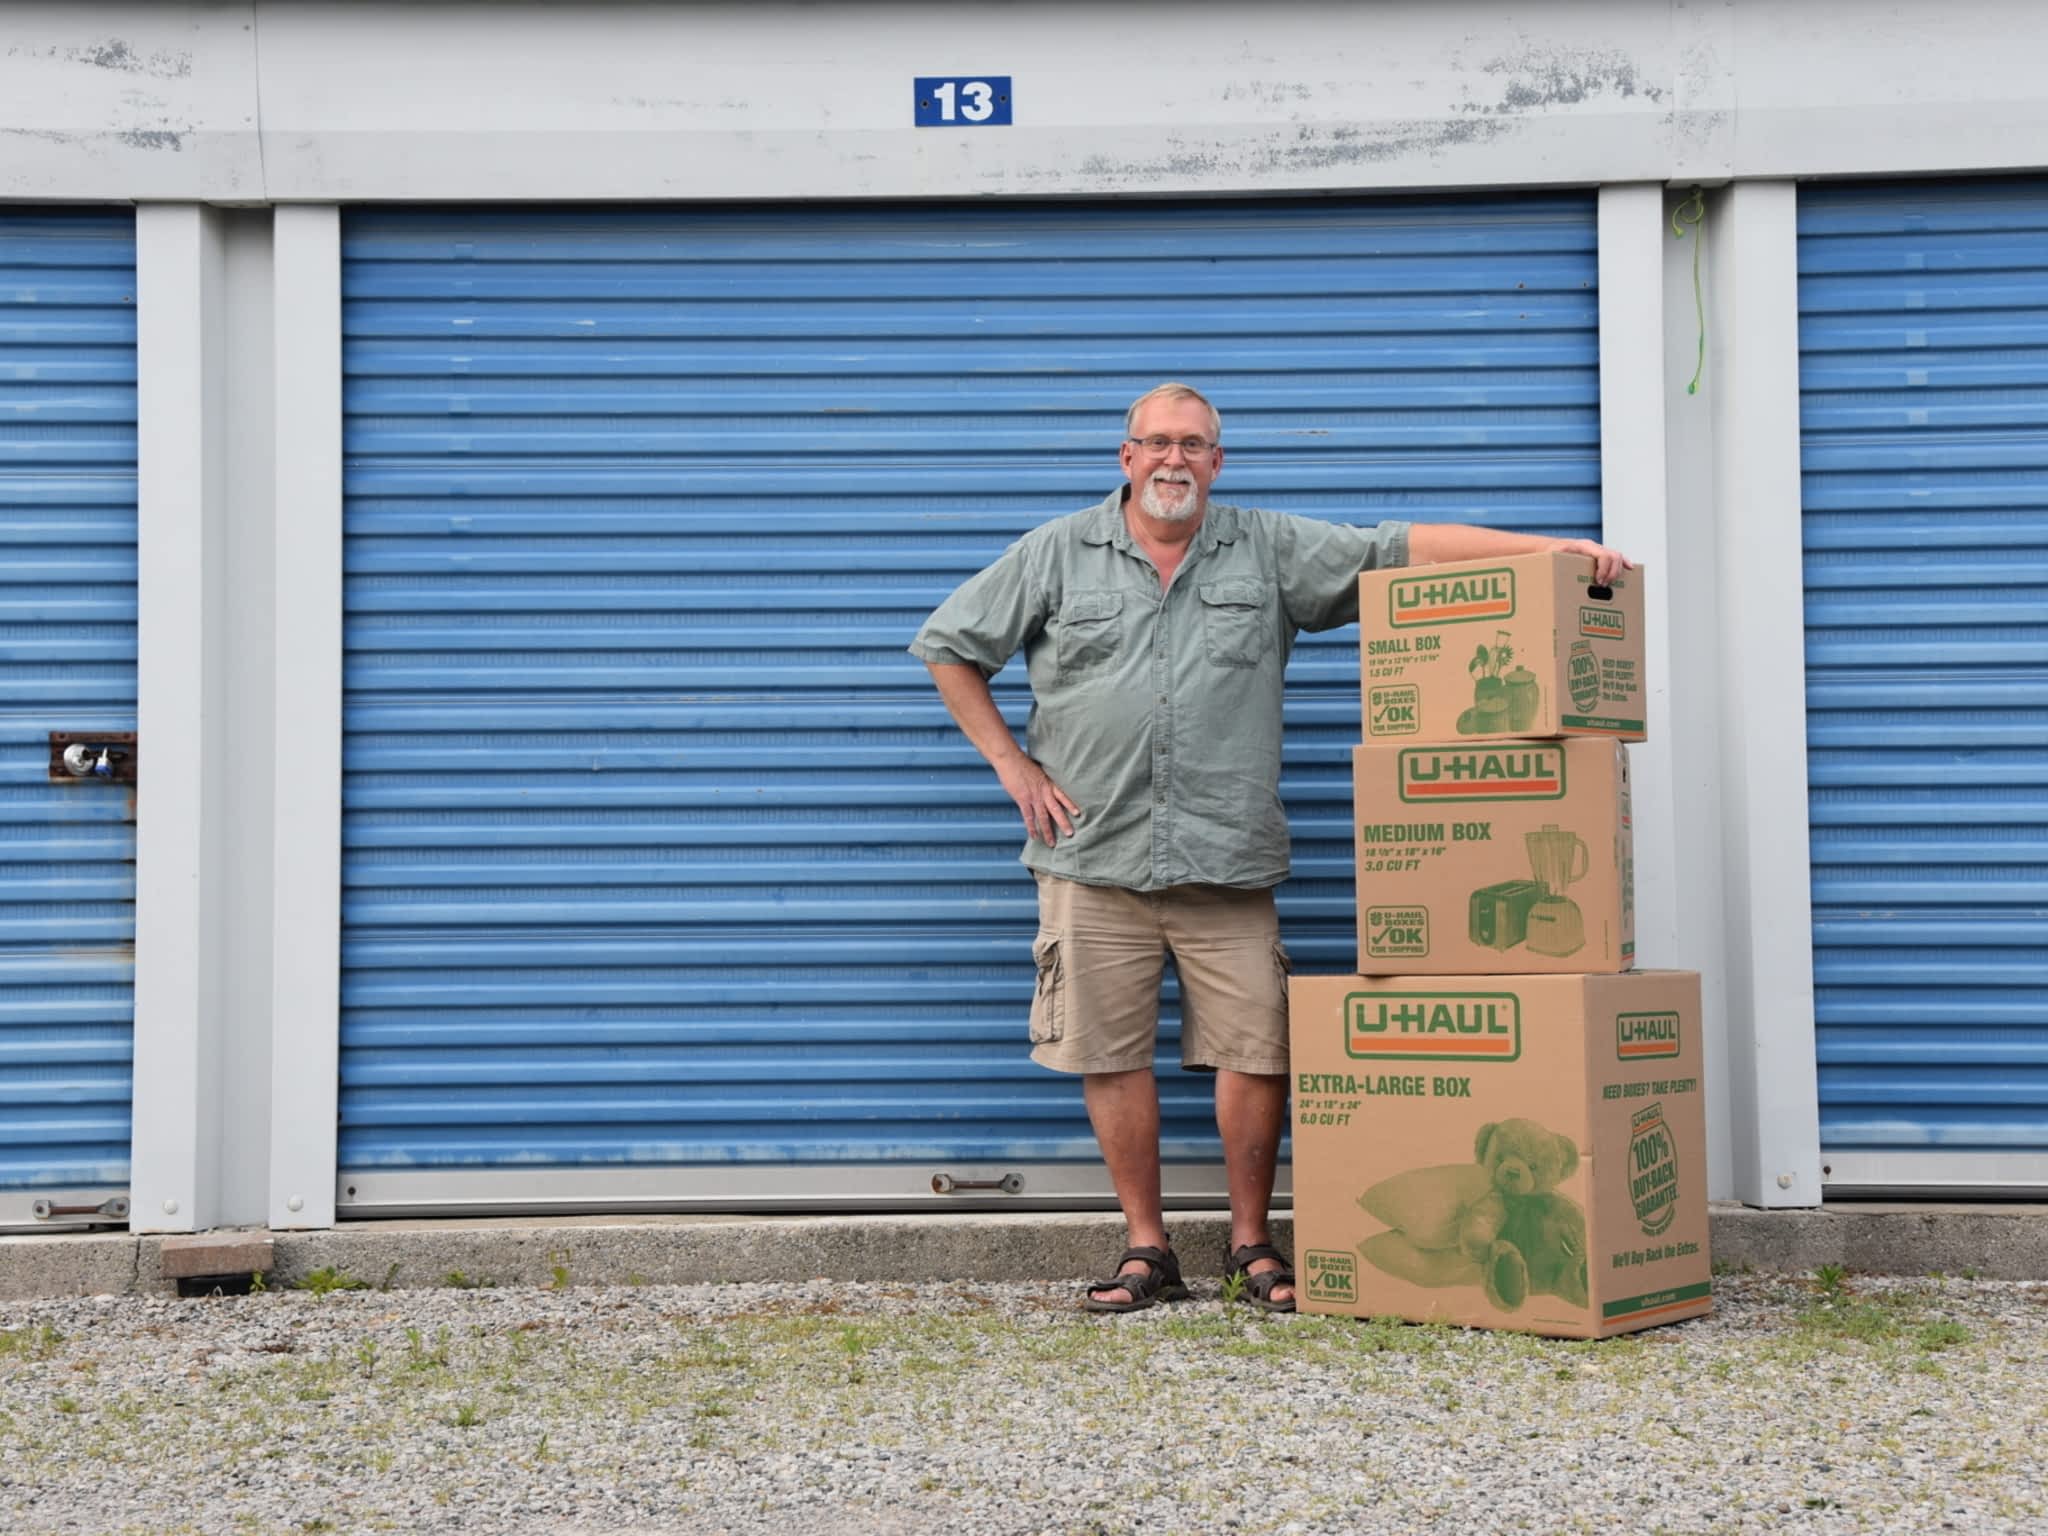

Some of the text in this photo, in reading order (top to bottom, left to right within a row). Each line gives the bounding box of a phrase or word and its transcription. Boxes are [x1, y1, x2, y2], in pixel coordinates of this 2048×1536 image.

[934, 82, 993, 121] 13
[1397, 577, 1507, 608] U-HAUL
[1583, 611, 1621, 628] U-HAUL
[1368, 634, 1441, 655] SMALL BOX
[1370, 666, 1404, 677] 1.5 CU FT
[1388, 706, 1415, 721] OK
[1410, 753, 1554, 781] U-HAUL
[1364, 822, 1492, 842] MEDIUM BOX
[1365, 859, 1421, 872] 3.0 CU FT
[1390, 928, 1423, 944] OK
[1356, 1003, 1508, 1033] U-HAUL
[1621, 1018, 1676, 1041] U-HAUL
[1298, 1073, 1471, 1097] EXTRA-LARGE BOX
[1301, 1113, 1351, 1126] 6.0 CU FT
[1633, 1129, 1669, 1172] 100%
[1631, 1250, 1645, 1267] Buy
[1646, 1246, 1662, 1262] Back
[1324, 1273, 1352, 1290] OK
